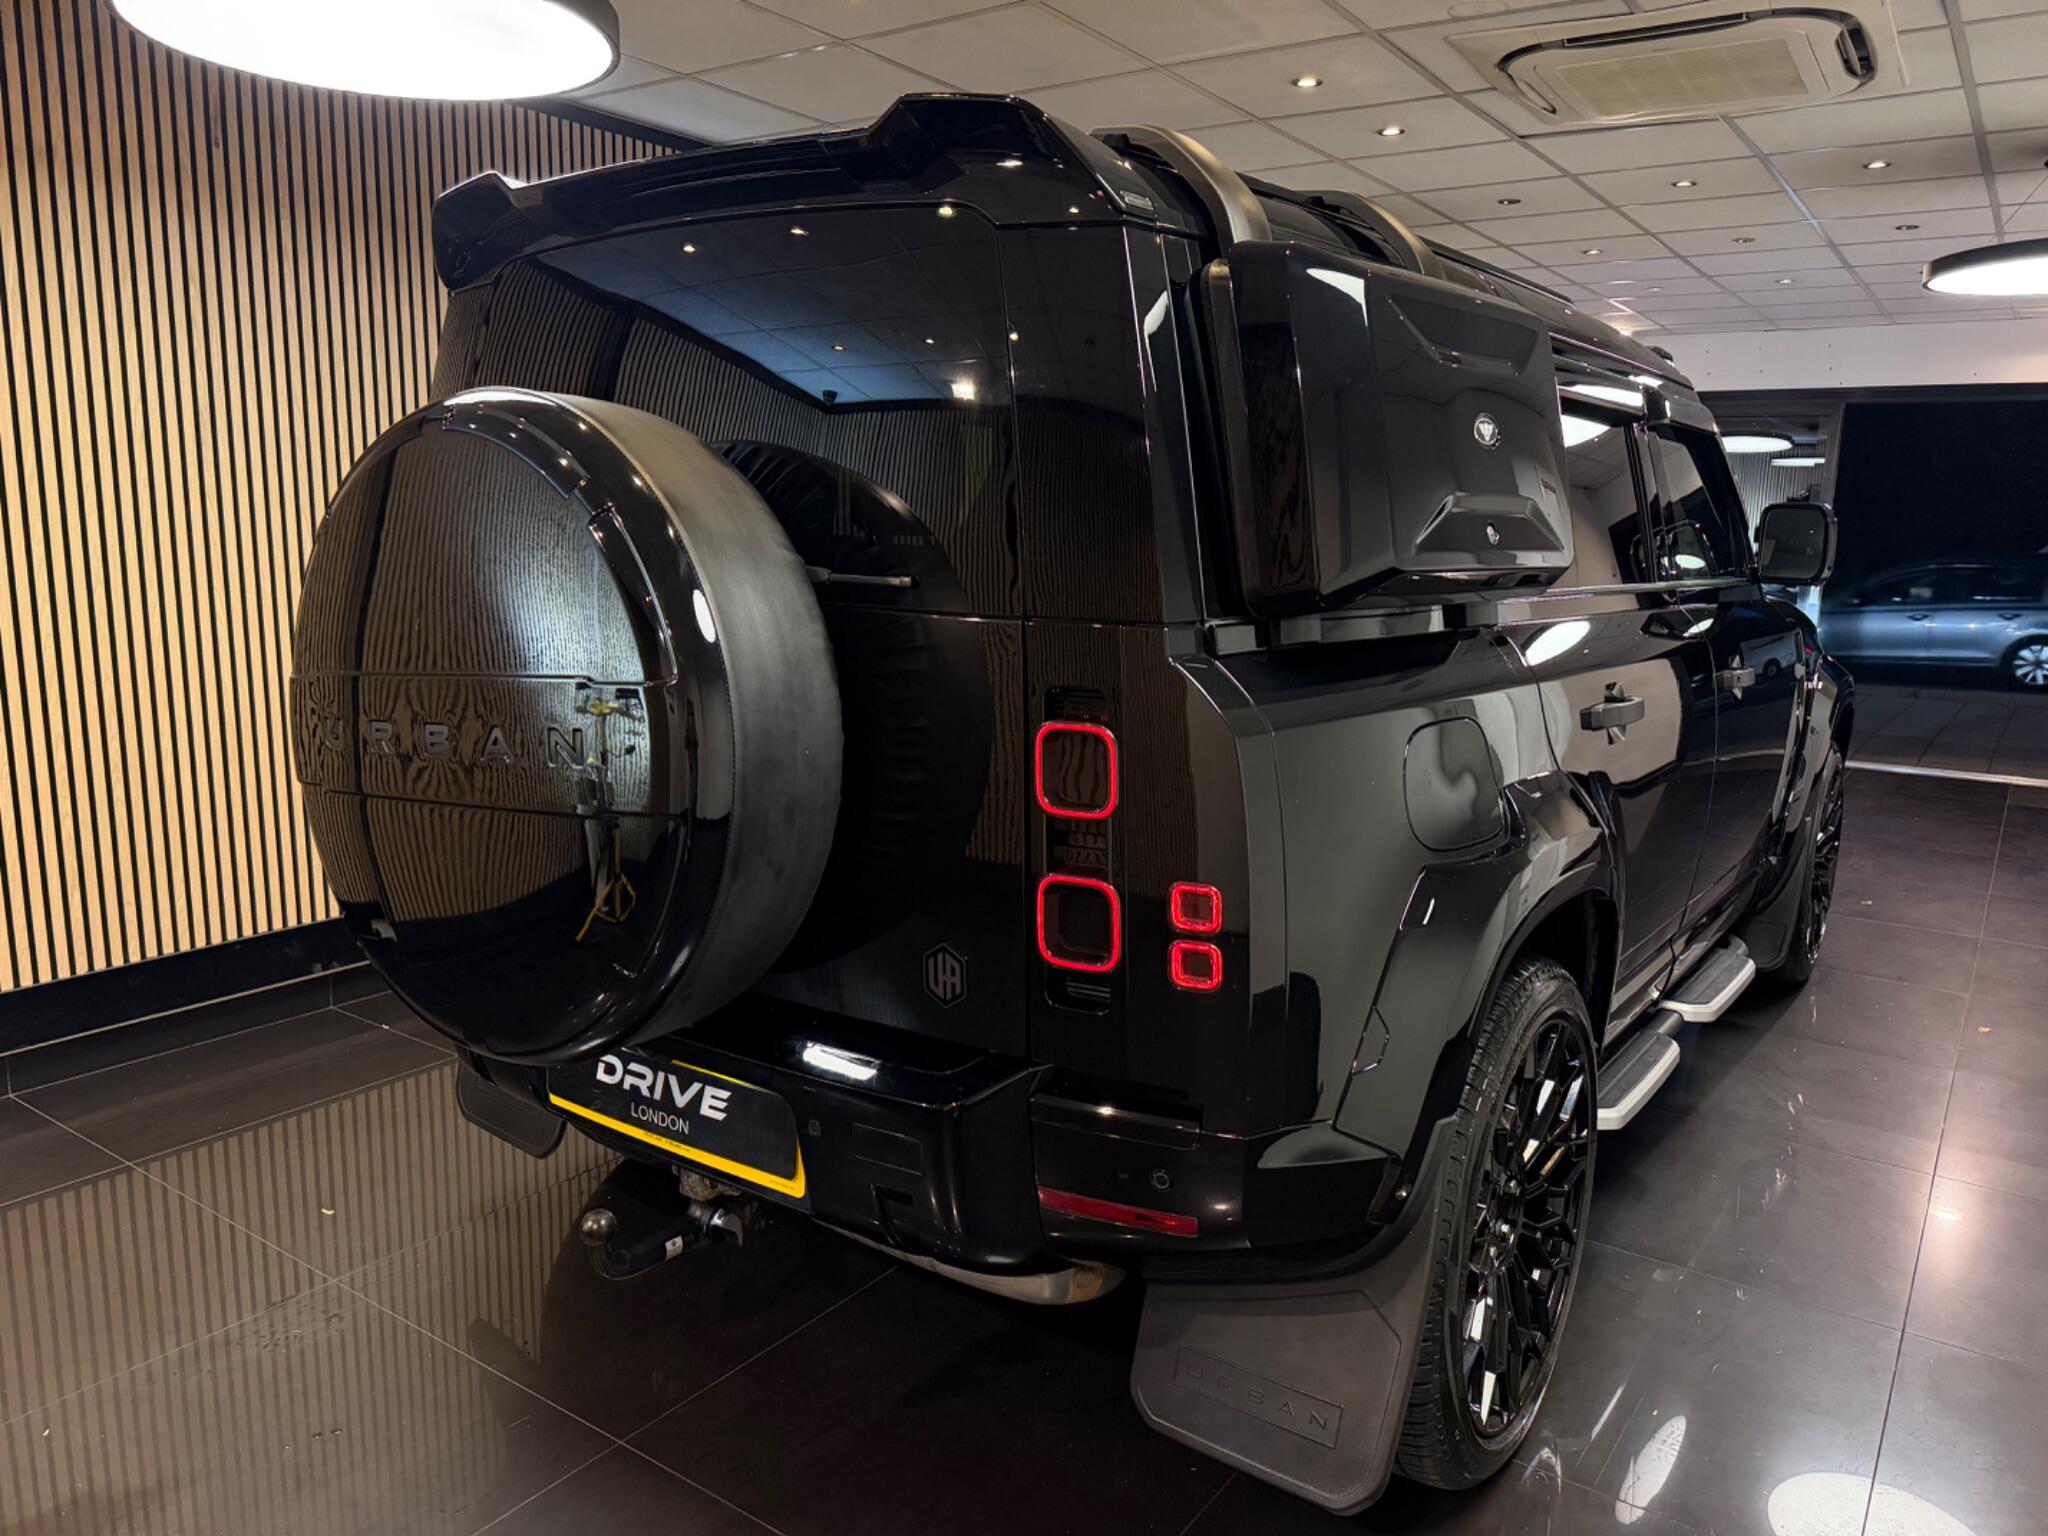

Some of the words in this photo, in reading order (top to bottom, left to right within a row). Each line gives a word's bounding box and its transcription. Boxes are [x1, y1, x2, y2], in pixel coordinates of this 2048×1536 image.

[323, 716, 584, 769] URBAN
[595, 1054, 732, 1121] DRIVE
[630, 1101, 690, 1135] LONDON
